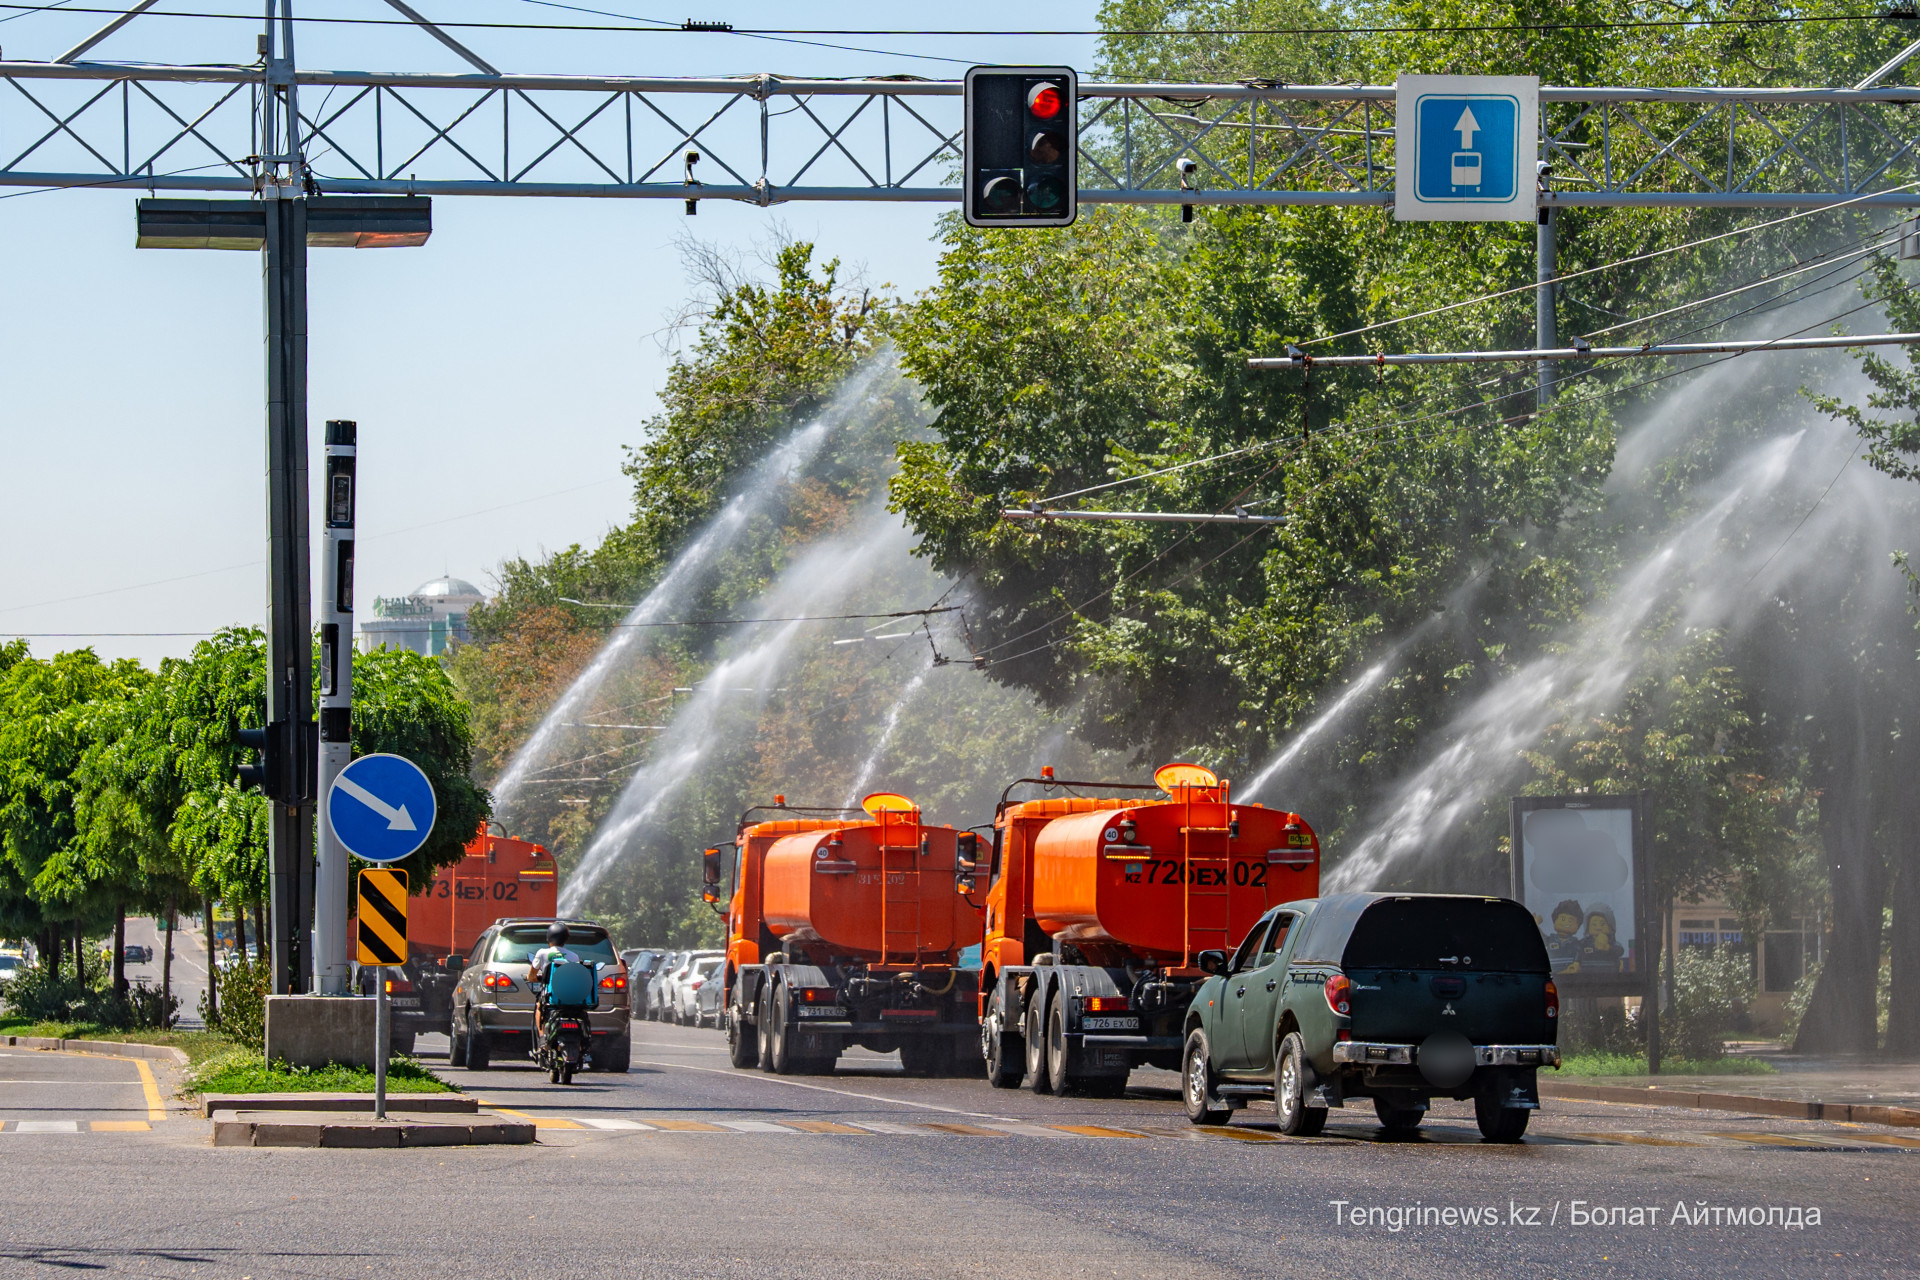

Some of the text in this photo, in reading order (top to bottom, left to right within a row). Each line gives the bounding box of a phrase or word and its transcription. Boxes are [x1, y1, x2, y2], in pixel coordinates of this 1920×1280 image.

[1106, 831, 1116, 839] 40
[1290, 835, 1309, 843] ВОДА
[818, 849, 828, 857] 40
[1125, 873, 1141, 883] KZ
[1233, 861, 1267, 887] 02
[493, 882, 518, 901] 02
[1094, 1019, 1109, 1027] 726
[1127, 1019, 1138, 1027] 02
